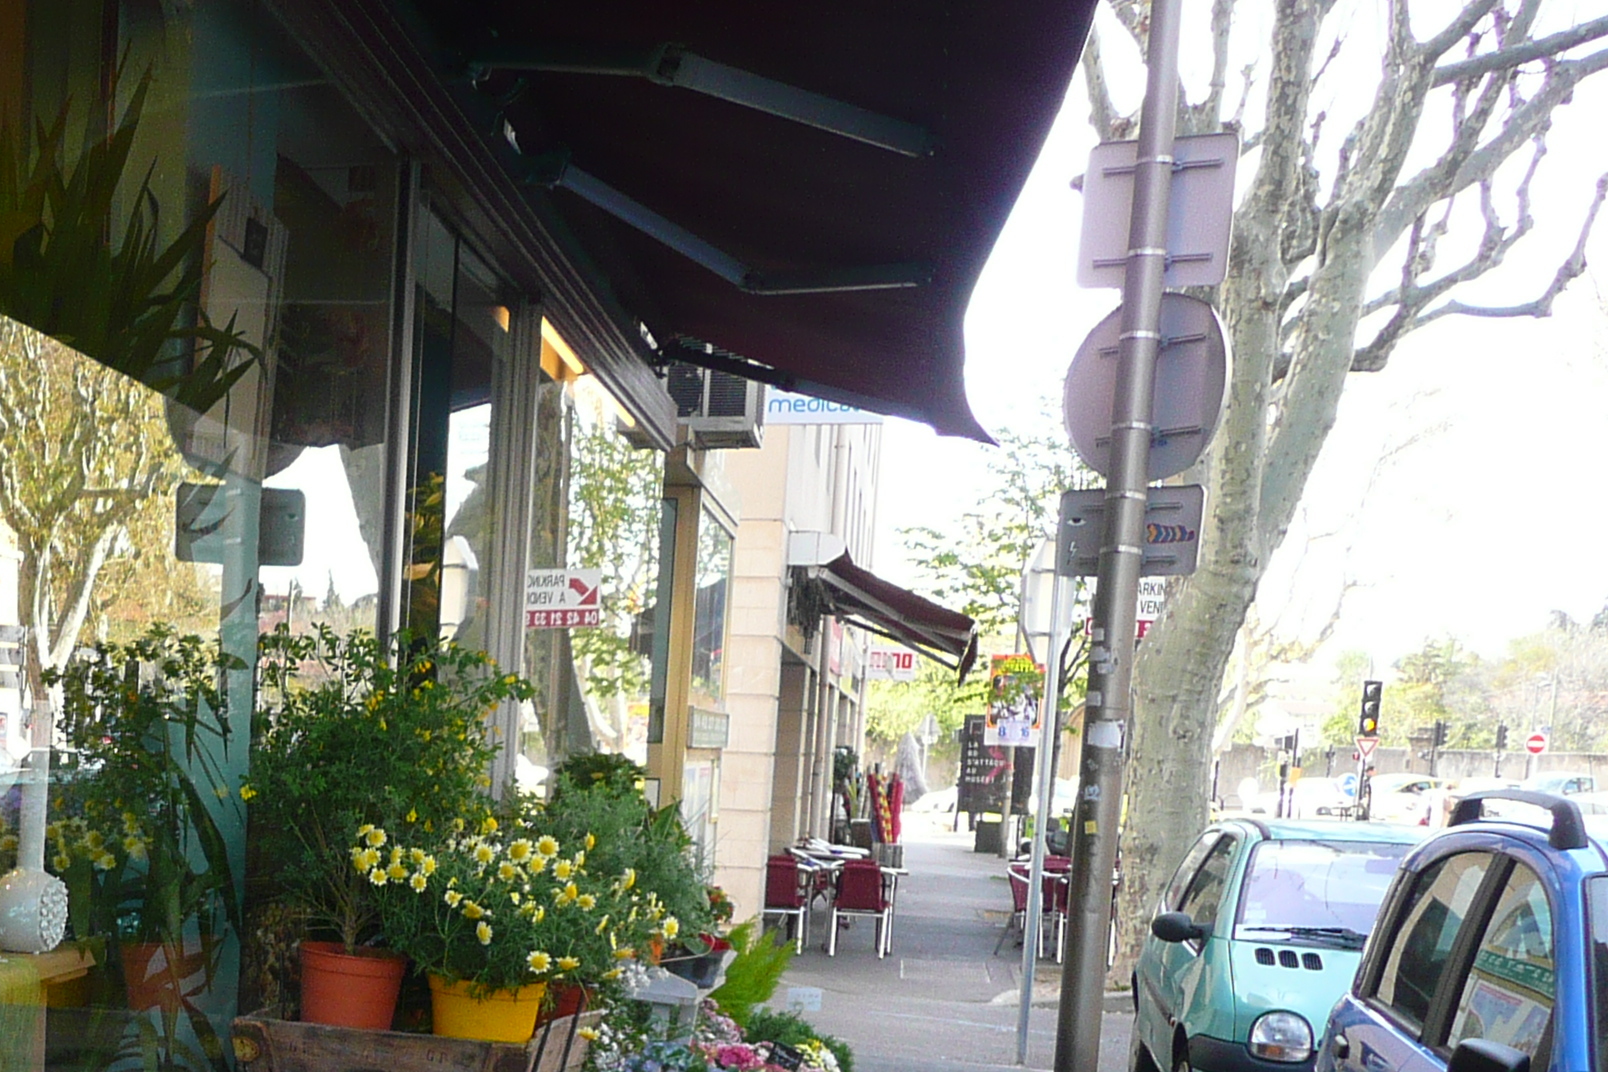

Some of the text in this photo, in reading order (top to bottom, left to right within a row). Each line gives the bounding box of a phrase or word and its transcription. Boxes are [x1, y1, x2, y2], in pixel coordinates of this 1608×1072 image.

[968, 741, 978, 749] LA
[967, 758, 1005, 767] S'ATTAQU
[966, 767, 977, 775] AU
